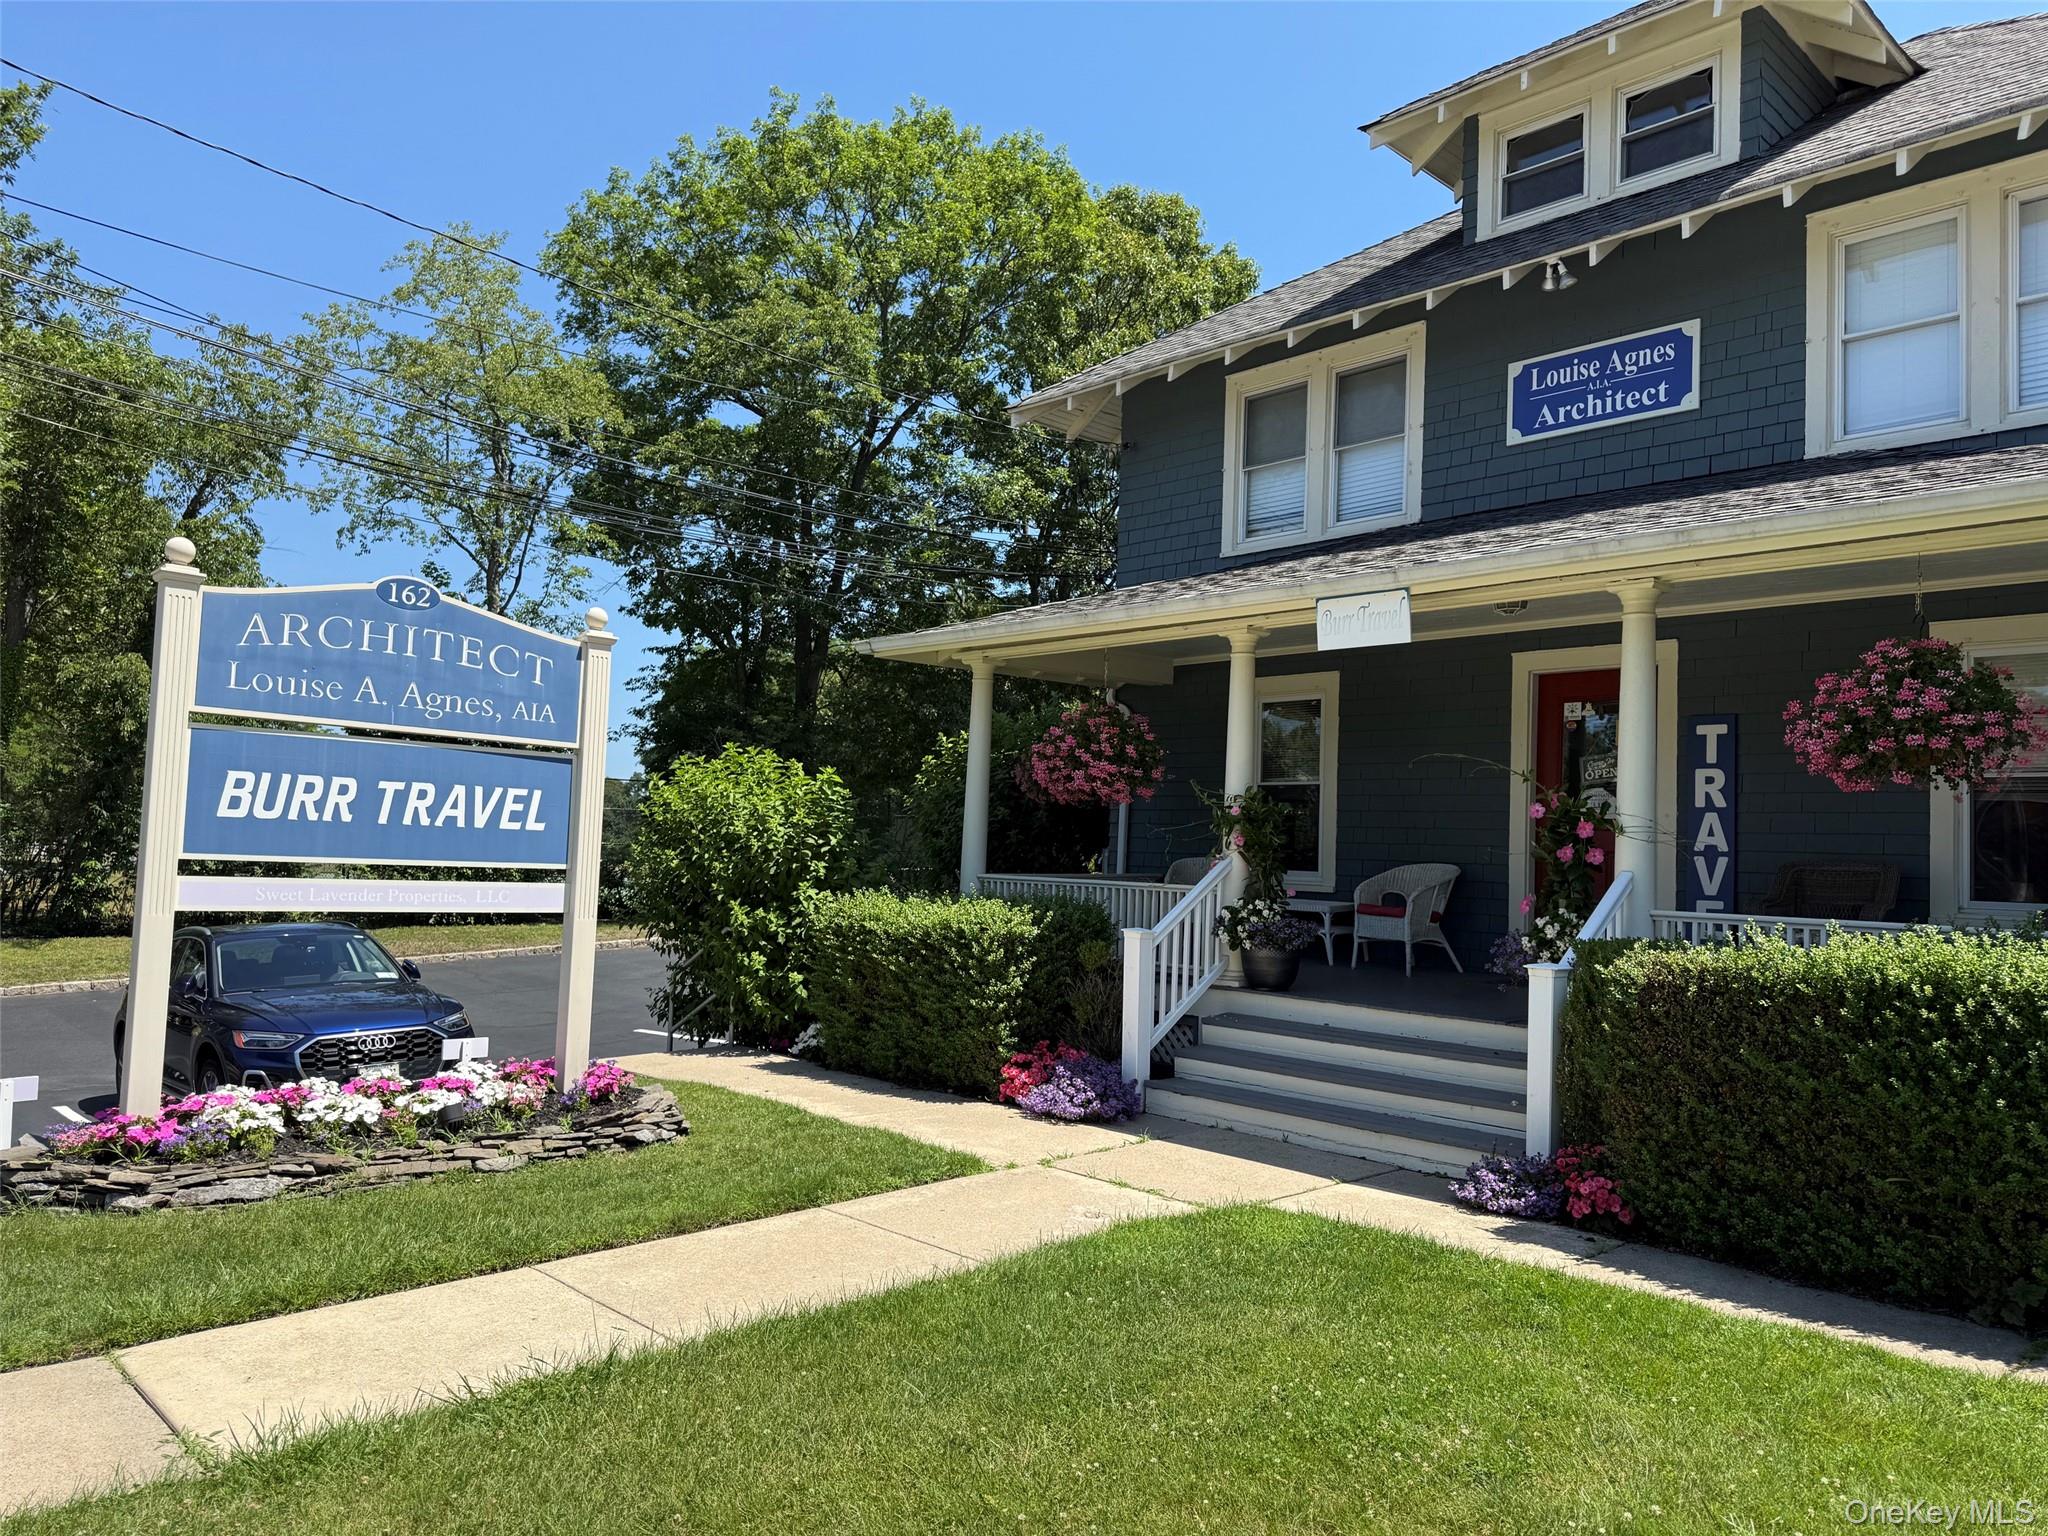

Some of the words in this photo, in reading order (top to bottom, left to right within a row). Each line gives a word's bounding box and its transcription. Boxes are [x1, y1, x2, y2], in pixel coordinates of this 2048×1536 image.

[1530, 358, 1600, 392] Louise
[1605, 342, 1675, 376] Agnes
[1533, 379, 1670, 429] Architect
[387, 581, 432, 609] 162
[1321, 609, 1355, 637] Burr
[1357, 596, 1406, 632] Travel
[237, 612, 554, 687] ARCHITECT
[227, 660, 344, 702] Louise
[353, 676, 389, 707] A.
[399, 681, 503, 723] Agnes,
[512, 701, 557, 725] AIA
[1585, 767, 1618, 781] OPEN
[216, 770, 358, 823] BURR
[376, 779, 547, 832] TRAVEL
[255, 887, 302, 902] Sweet
[310, 887, 383, 903] Lavender
[476, 890, 511, 904] LLC
